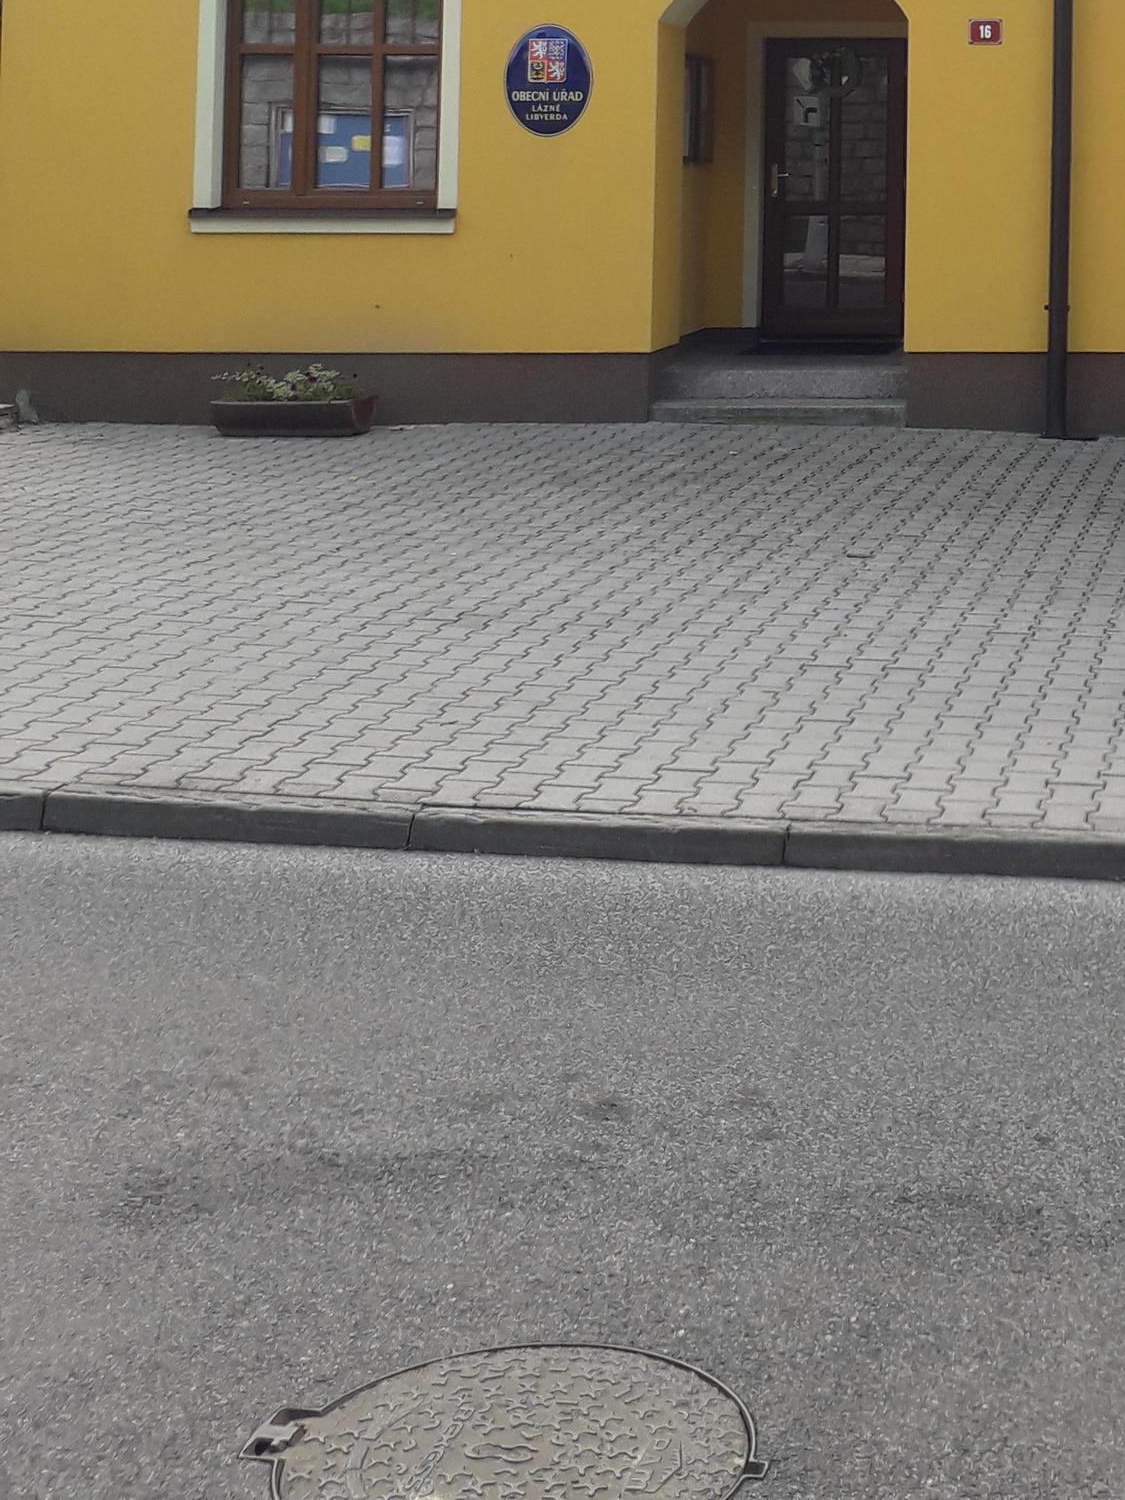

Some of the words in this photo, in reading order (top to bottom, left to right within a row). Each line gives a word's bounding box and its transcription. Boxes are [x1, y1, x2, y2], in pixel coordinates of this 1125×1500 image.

[979, 25, 992, 39] 16
[511, 88, 549, 101] OBECNÍ
[552, 88, 584, 101] ÚŘAD
